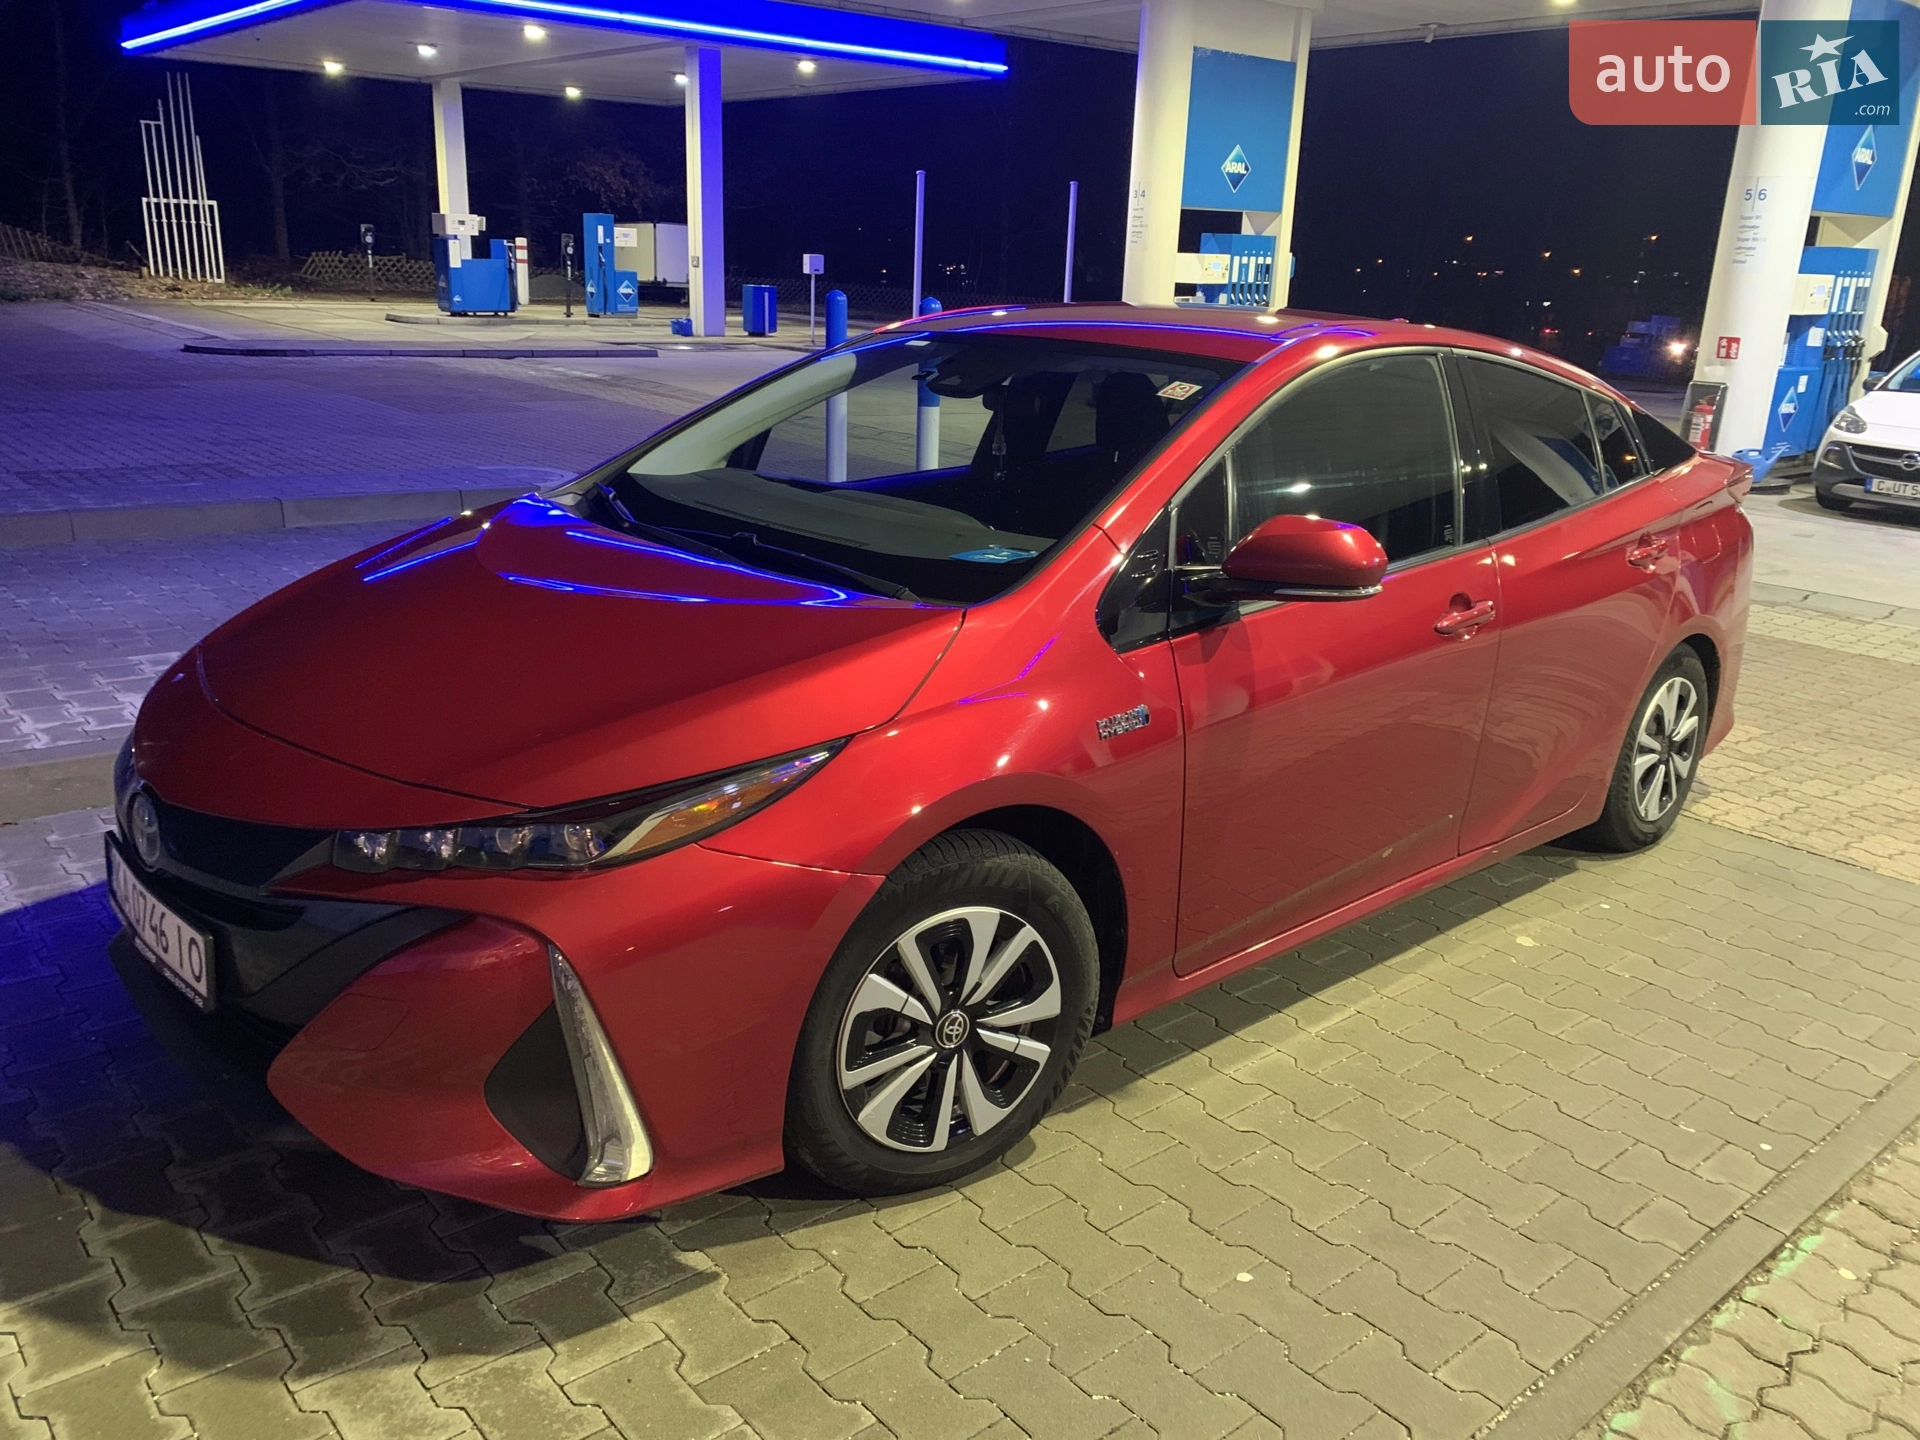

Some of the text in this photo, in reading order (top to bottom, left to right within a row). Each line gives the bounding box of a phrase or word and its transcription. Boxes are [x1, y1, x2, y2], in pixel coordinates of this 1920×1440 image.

[1225, 161, 1247, 174] ARAL
[1744, 188, 1767, 201] 5 6
[1876, 480, 1886, 491] C
[1893, 483, 1909, 495] UT
[1099, 717, 1142, 741] HYBRID
